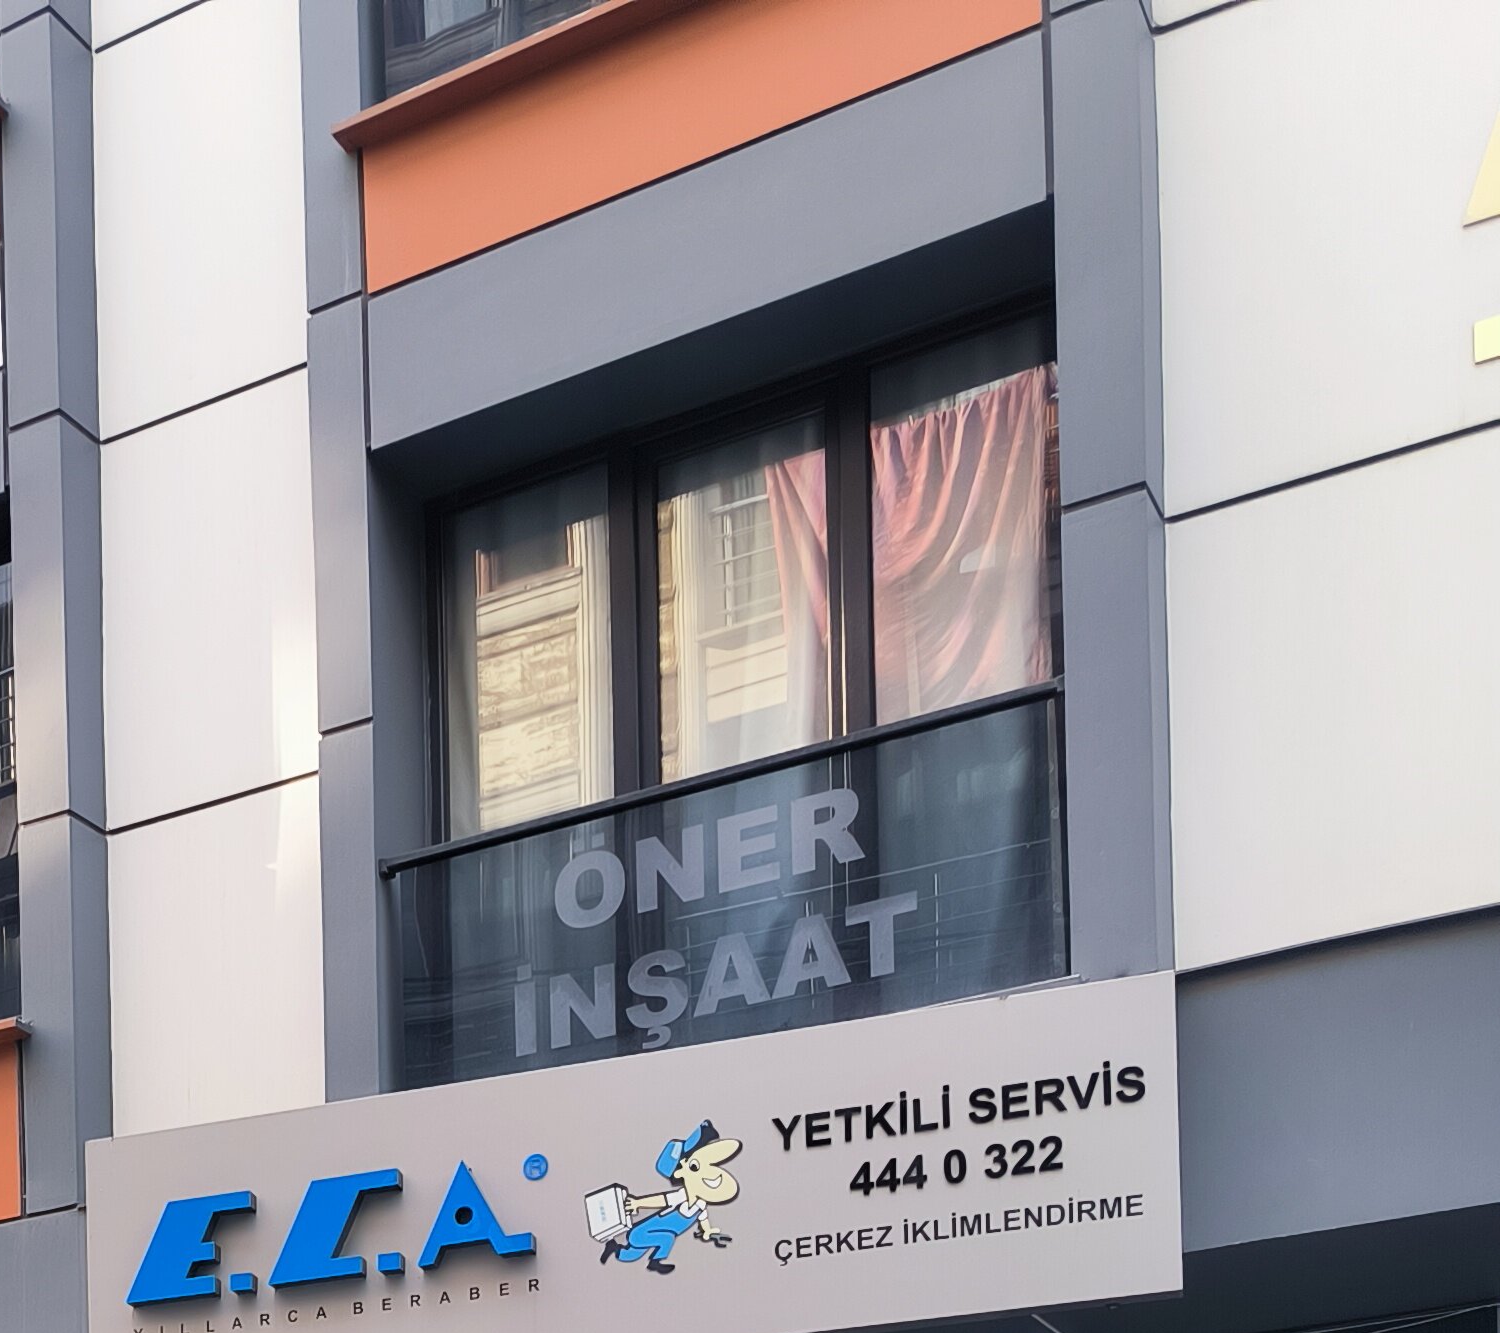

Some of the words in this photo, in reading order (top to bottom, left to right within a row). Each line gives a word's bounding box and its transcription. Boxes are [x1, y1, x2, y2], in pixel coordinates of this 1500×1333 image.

[554, 787, 866, 930] ÖNER
[514, 890, 918, 1058] İNŞAAT
[771, 1084, 951, 1151] YETKİLİ
[968, 1060, 1146, 1125] SERVİS
[850, 1154, 928, 1196] 444
[943, 1148, 968, 1185] 0
[984, 1135, 1065, 1179] 322
[774, 1225, 894, 1267] ÇERKEZ
[902, 1194, 1145, 1245] İKLİMLENDİRME
[352, 1277, 541, 1316] BERABER
